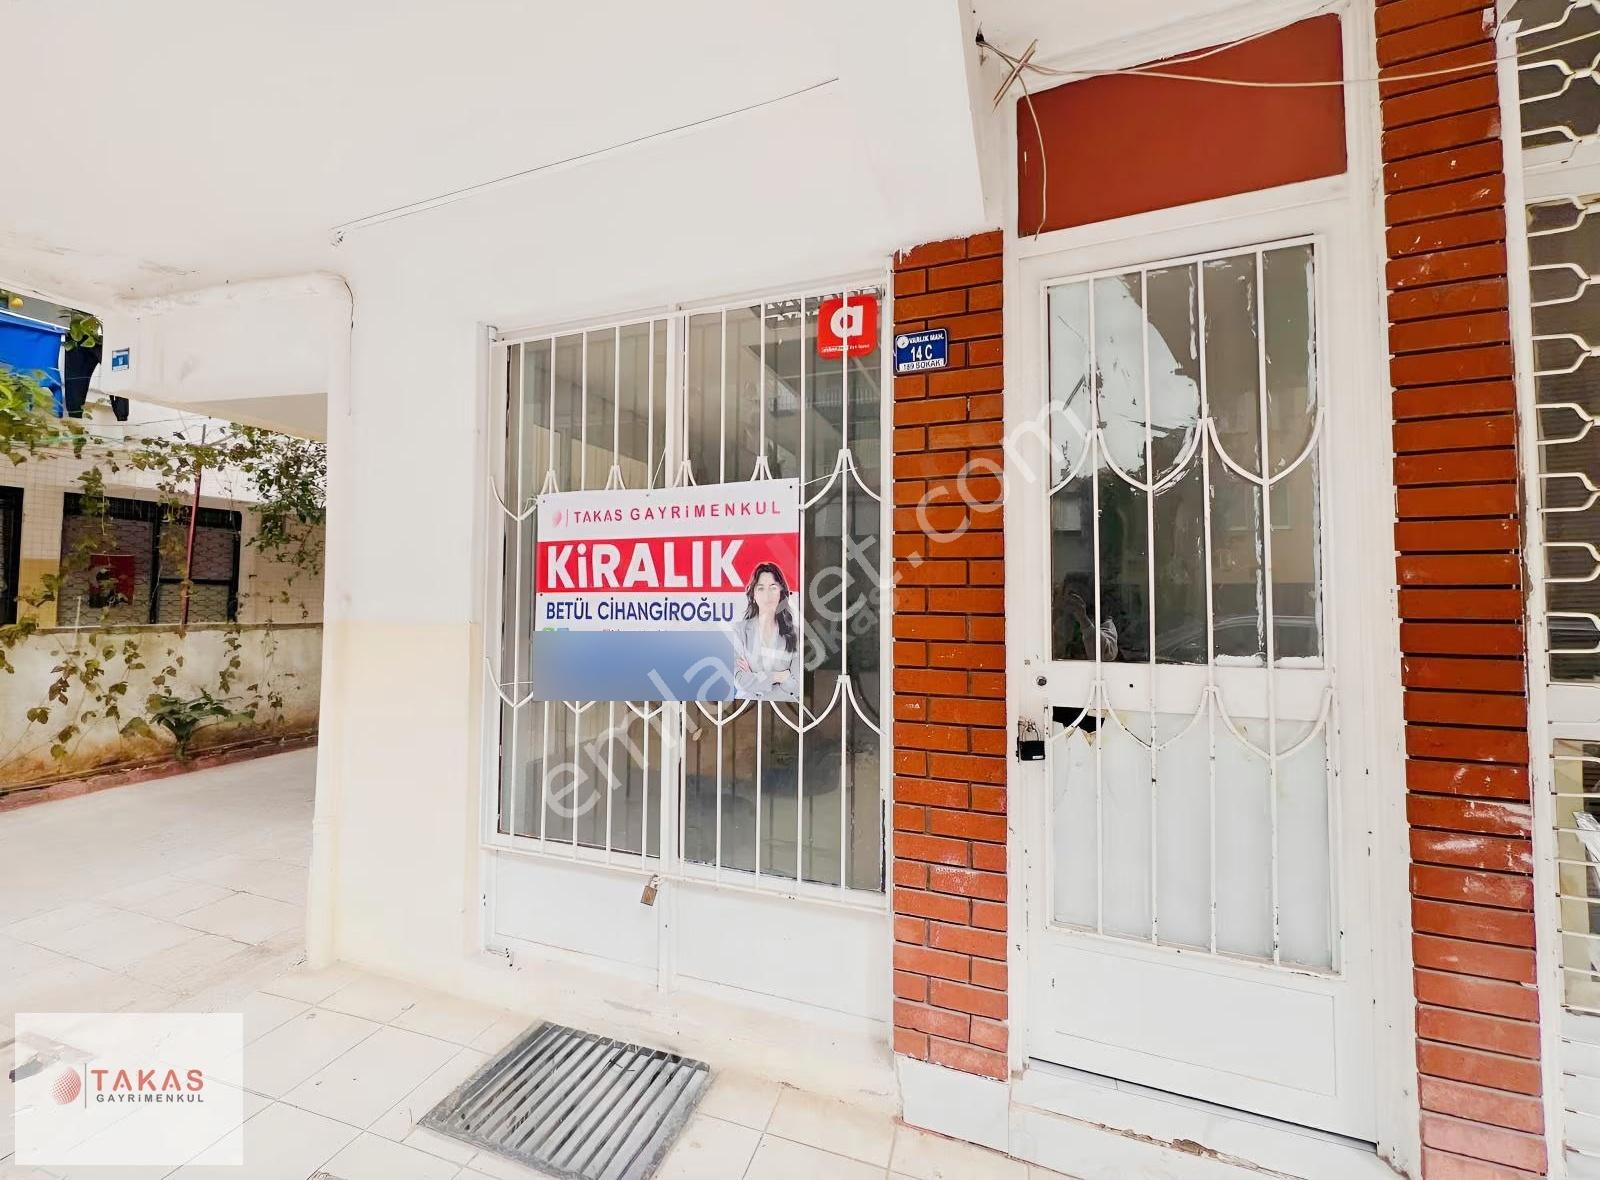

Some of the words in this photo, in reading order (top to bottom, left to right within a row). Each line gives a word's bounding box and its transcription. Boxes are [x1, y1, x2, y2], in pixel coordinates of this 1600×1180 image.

[911, 346, 922, 361] 14
[925, 345, 932, 359] C
[916, 360, 940, 368] SOKAK
[573, 509, 623, 524] TAKAS
[546, 597, 592, 620] BETÜL
[597, 596, 734, 622] CİHANGİROĞLU
